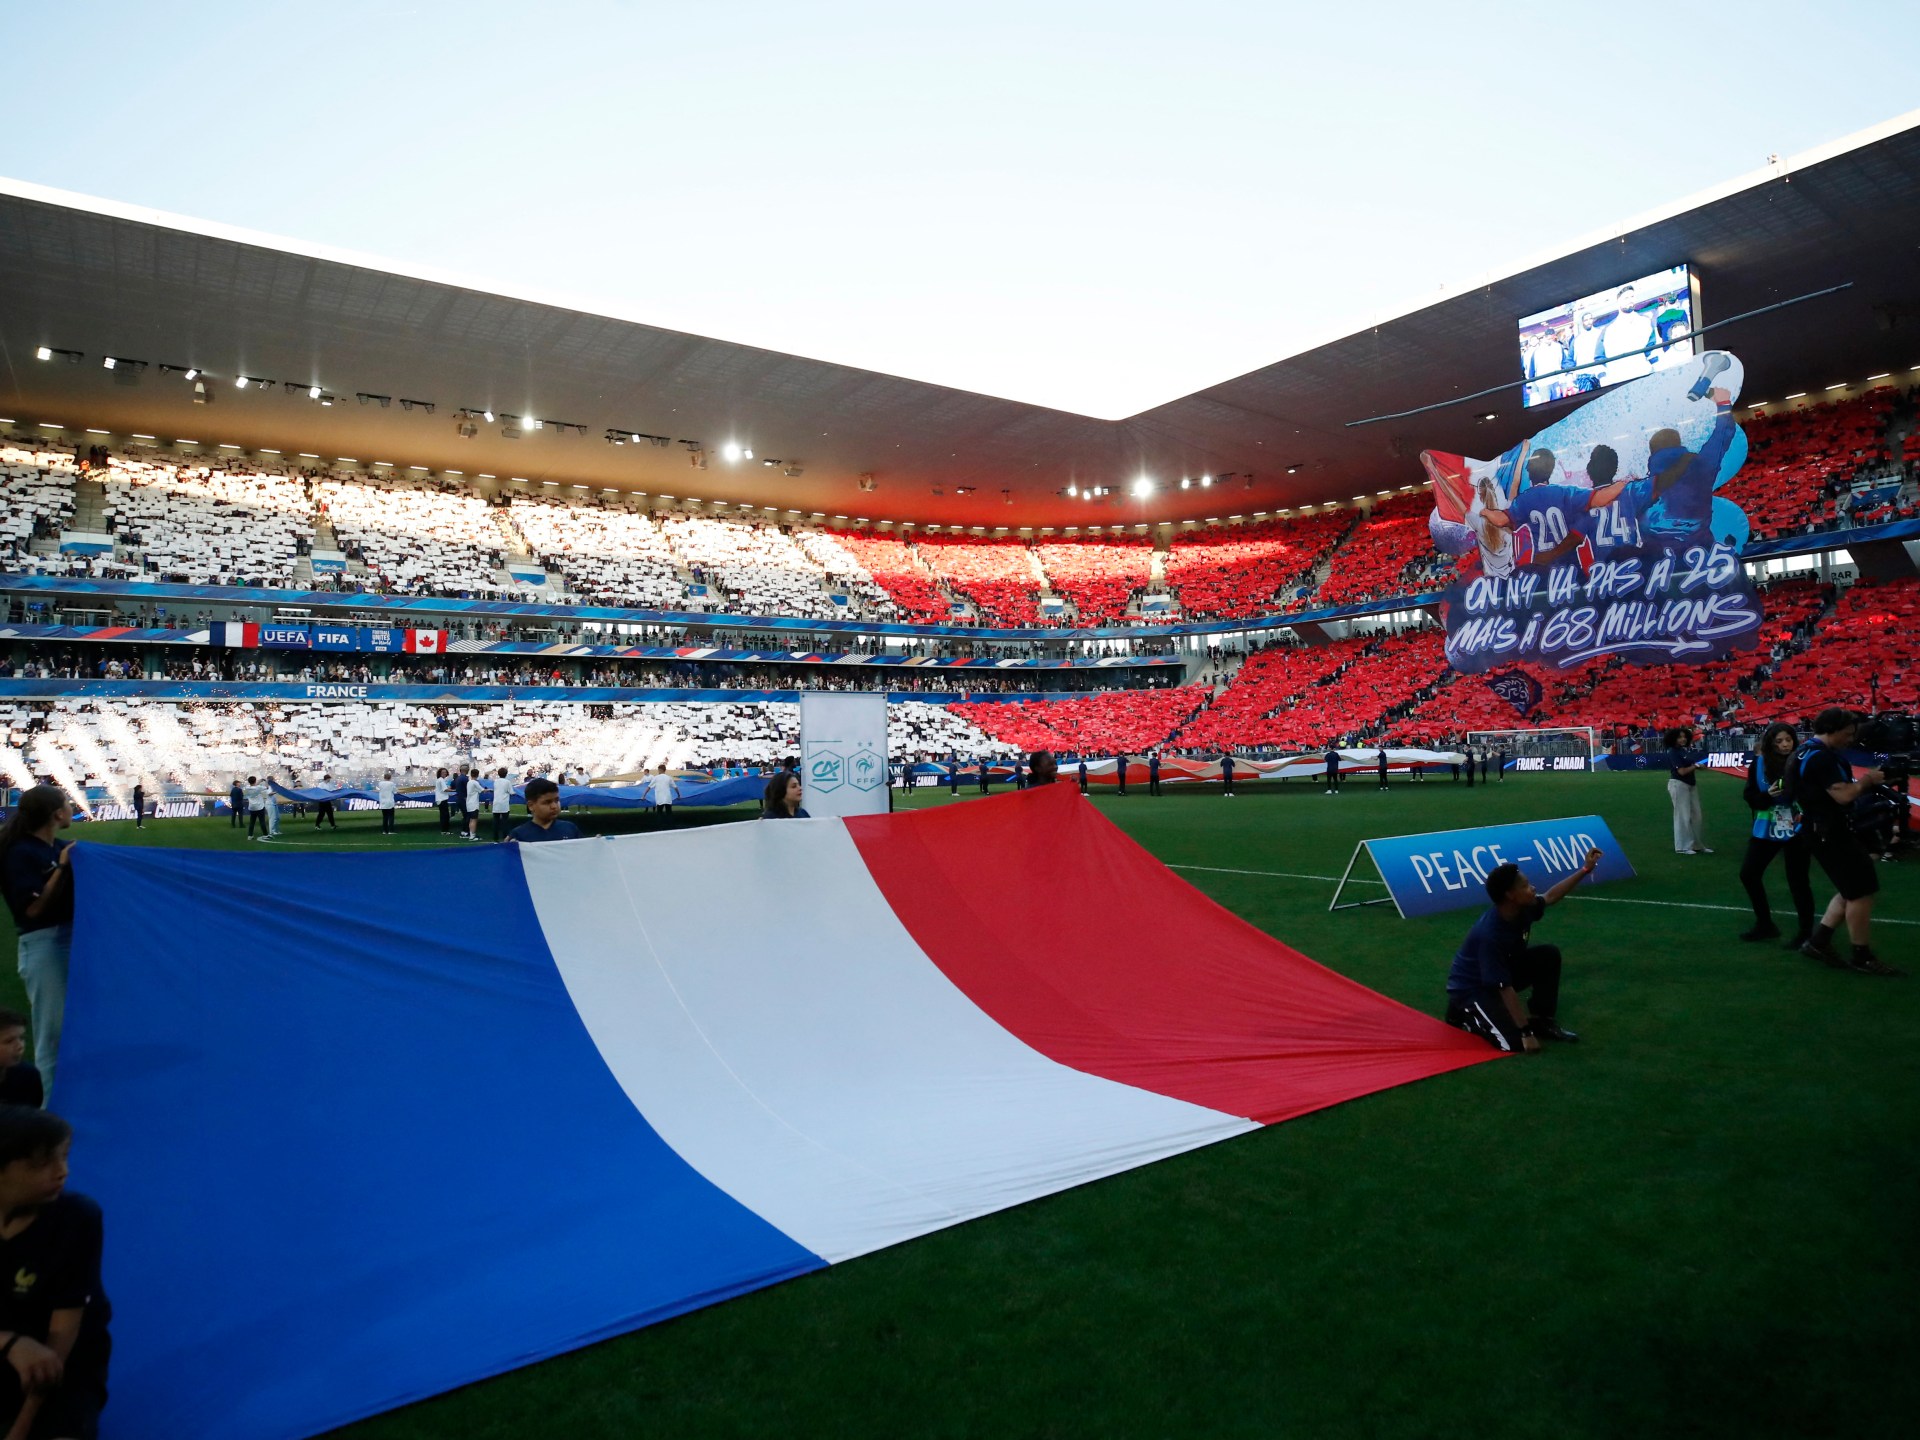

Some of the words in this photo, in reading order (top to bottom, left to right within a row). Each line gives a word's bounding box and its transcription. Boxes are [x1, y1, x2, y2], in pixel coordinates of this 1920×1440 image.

[1529, 506, 1569, 552] 20
[1589, 500, 1631, 547] 24
[1466, 577, 1500, 611] ON
[1549, 566, 1577, 602] VA
[1583, 558, 1641, 598] PAS
[1680, 543, 1735, 588] 25
[1831, 571, 1852, 579] BAR
[264, 631, 306, 642] UEFA
[1541, 608, 1596, 651] 68
[318, 633, 350, 644] FIFA
[307, 685, 367, 697] FRANCE
[1516, 757, 1545, 771] FRANCE
[1553, 756, 1585, 770] CANADA
[1707, 752, 1744, 767] FRANCE
[916, 775, 938, 787] CANADA
[155, 802, 200, 819] CANADA
